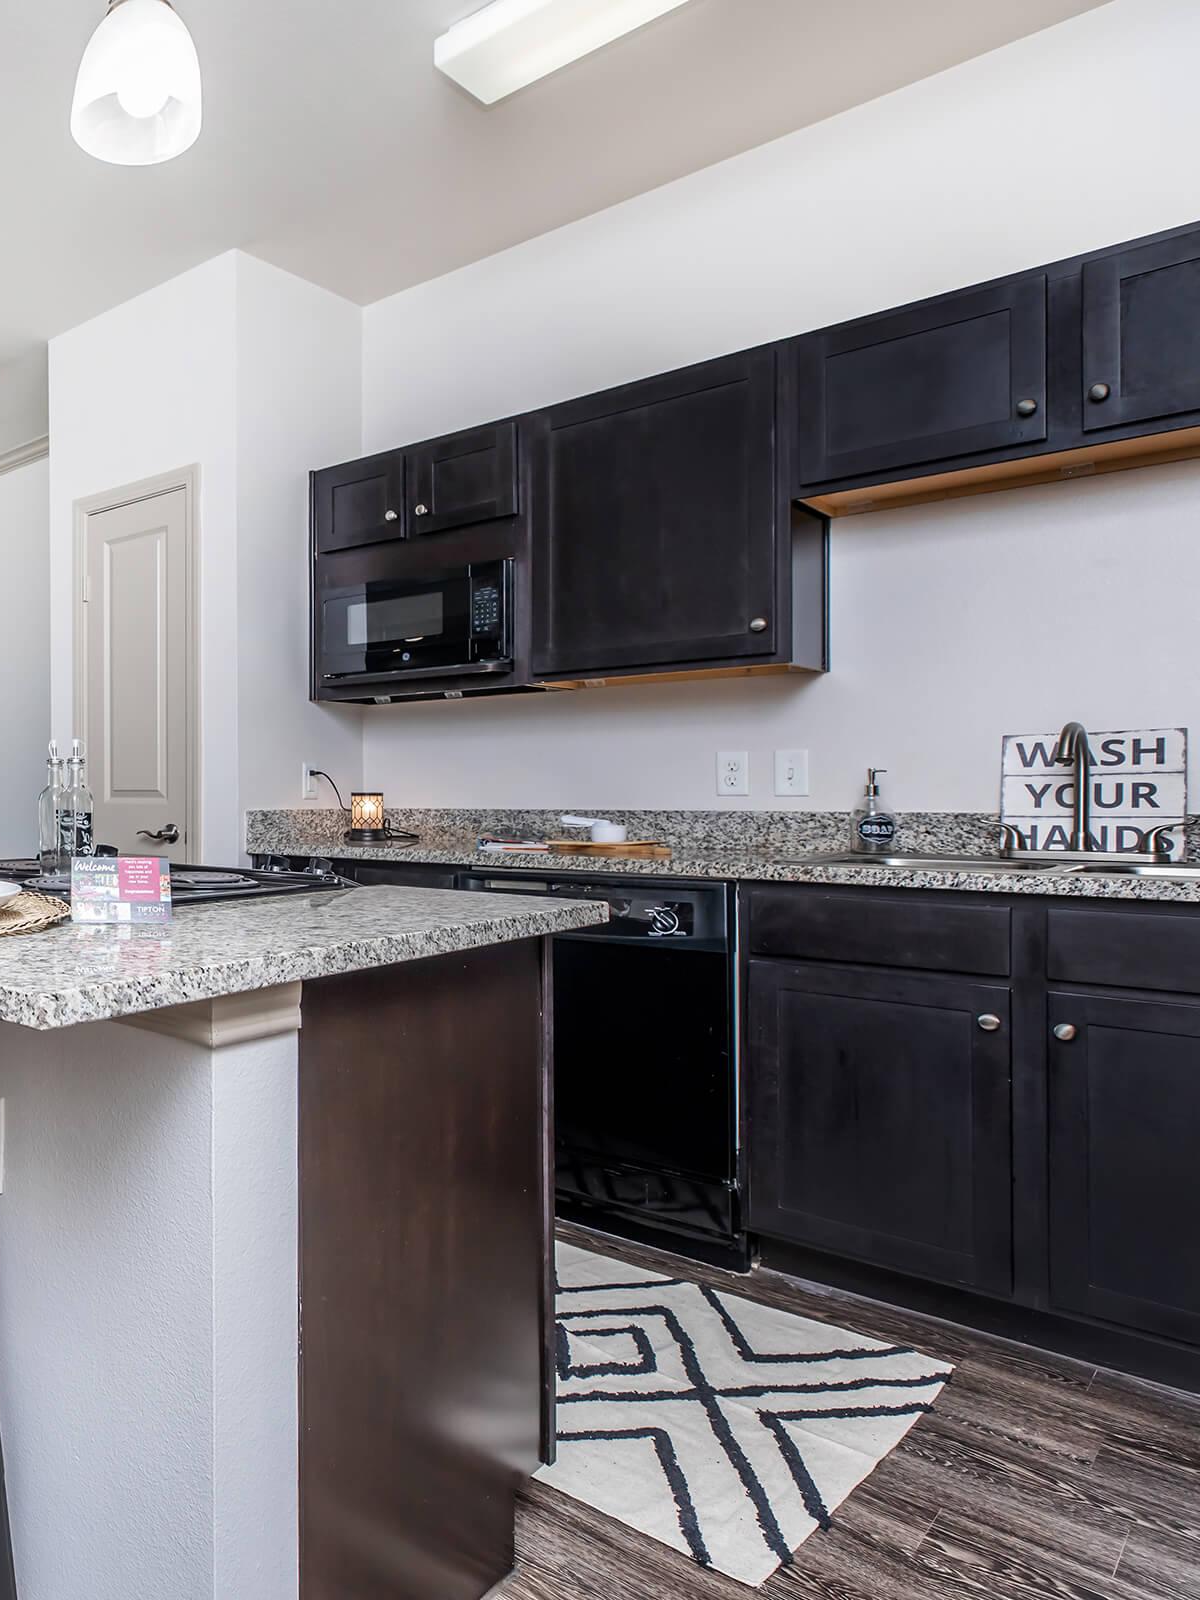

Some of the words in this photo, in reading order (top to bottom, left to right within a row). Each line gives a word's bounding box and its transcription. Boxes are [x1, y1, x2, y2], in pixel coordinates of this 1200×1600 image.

[1025, 782, 1161, 809] YOUR
[862, 824, 894, 835] SOAP
[74, 860, 116, 872] Welcome
